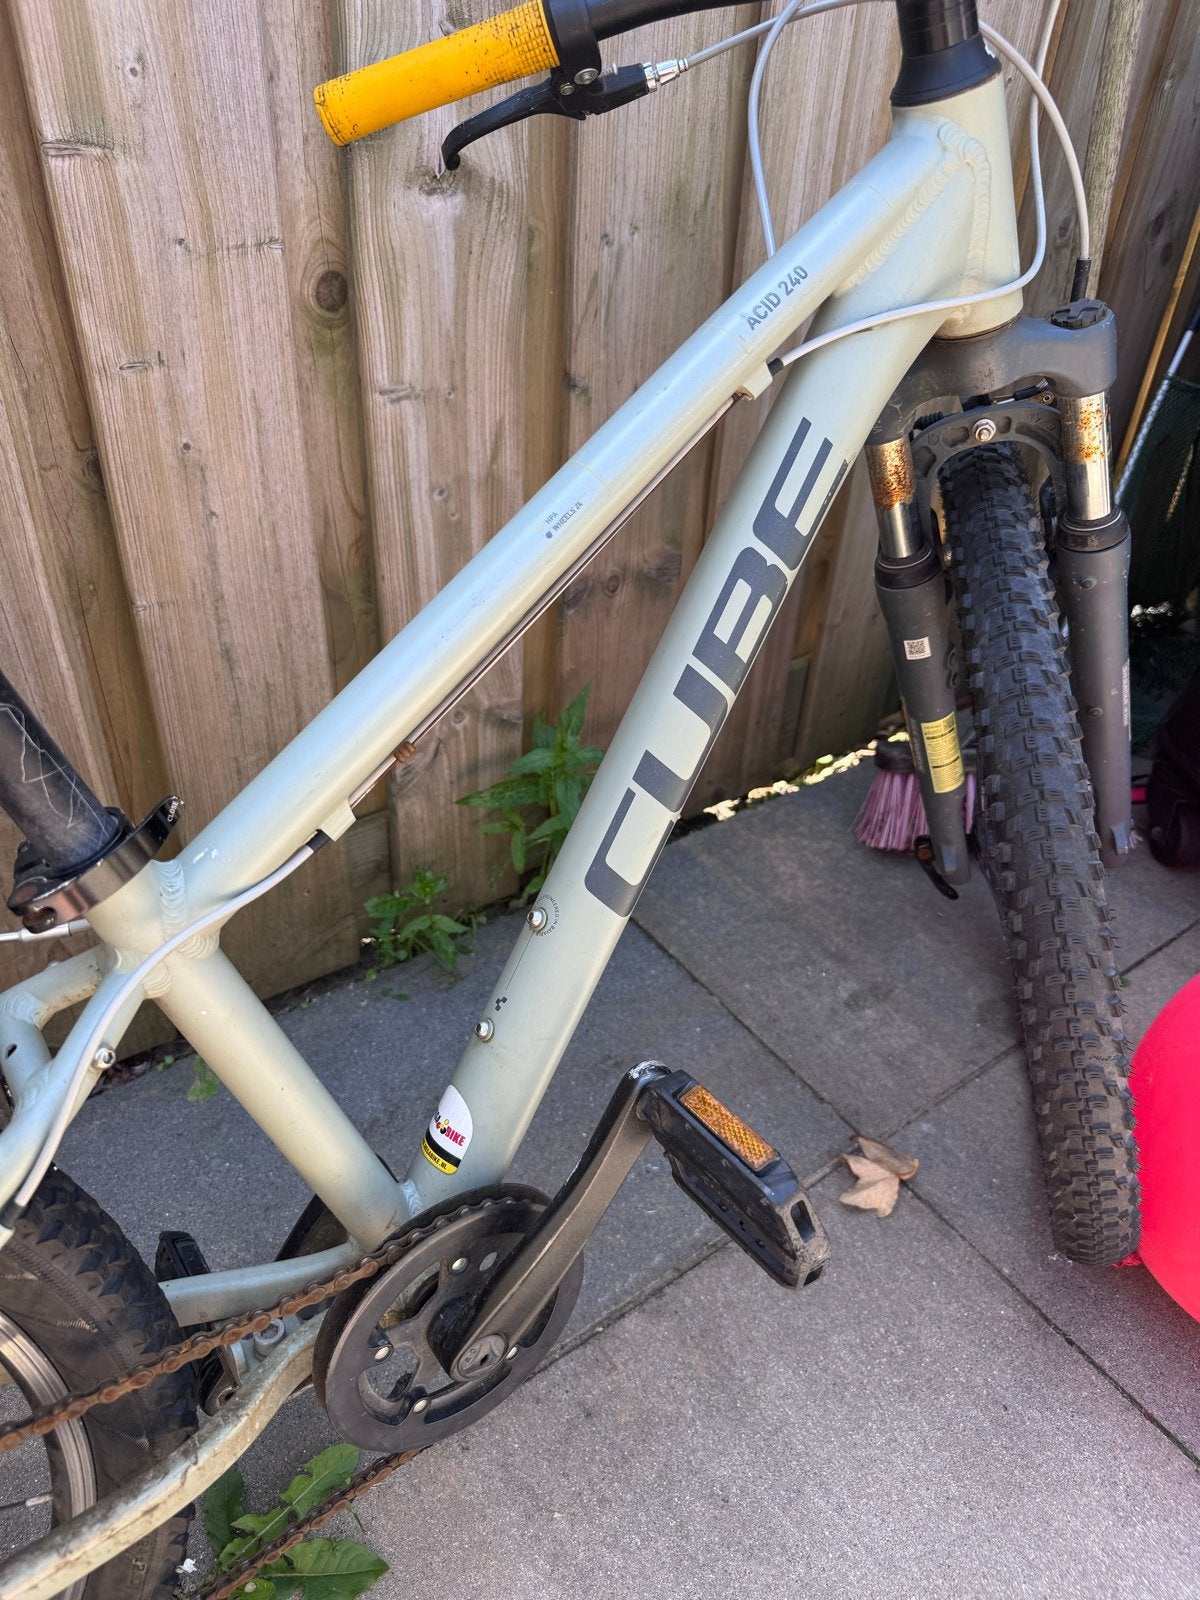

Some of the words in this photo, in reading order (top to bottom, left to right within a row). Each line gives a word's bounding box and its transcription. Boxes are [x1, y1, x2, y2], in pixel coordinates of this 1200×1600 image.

[746, 291, 781, 331] ACID
[777, 265, 809, 296] 240
[552, 506, 577, 531] WHEELS
[584, 416, 849, 918] CUBE
[445, 1125, 466, 1147] BIKE
